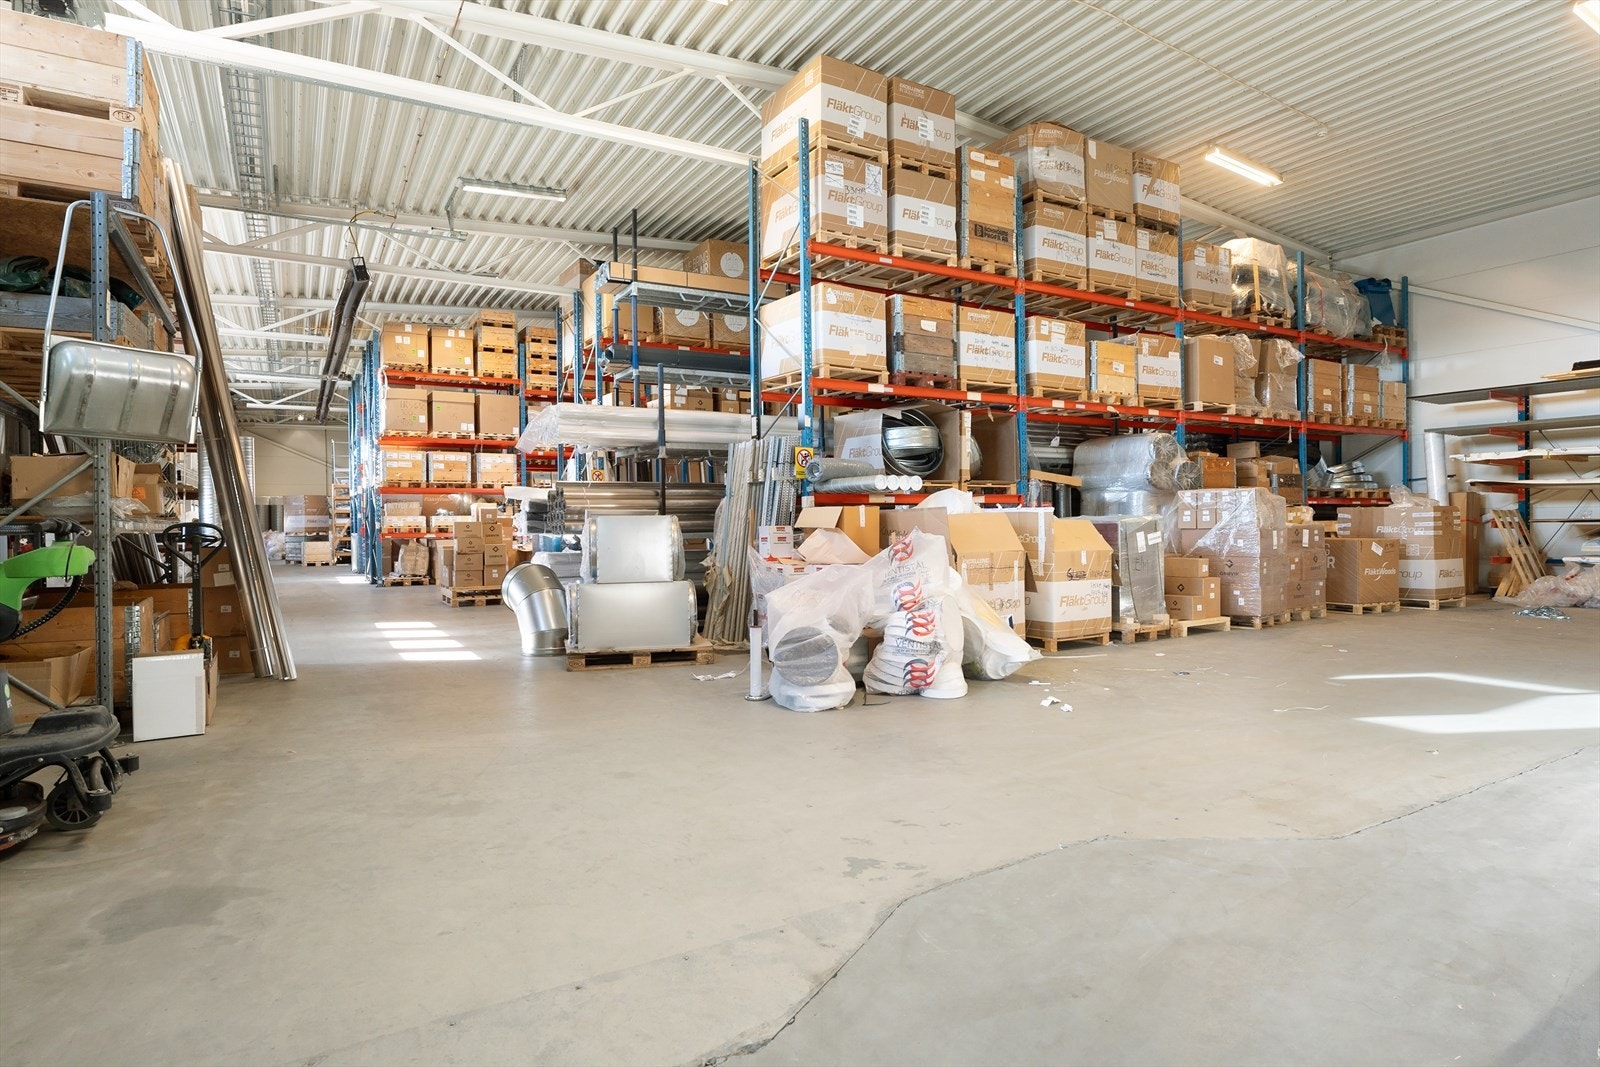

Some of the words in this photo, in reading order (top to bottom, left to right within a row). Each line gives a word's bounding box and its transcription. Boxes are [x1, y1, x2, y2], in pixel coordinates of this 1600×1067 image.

[826, 97, 882, 126] FläktGroup
[900, 117, 952, 142] Fläkroup
[902, 208, 953, 230] Fläkroup
[1041, 237, 1084, 256] FläktGroup
[1095, 249, 1134, 267] FläktGroup
[1140, 260, 1176, 276] FläktGroup
[829, 324, 882, 344] Fläkroup
[966, 343, 1012, 360] FläktGroup
[1042, 352, 1083, 368] FläktGroup
[1142, 365, 1178, 379] FläktGroup
[1060, 594, 1108, 608] FläktGroup
